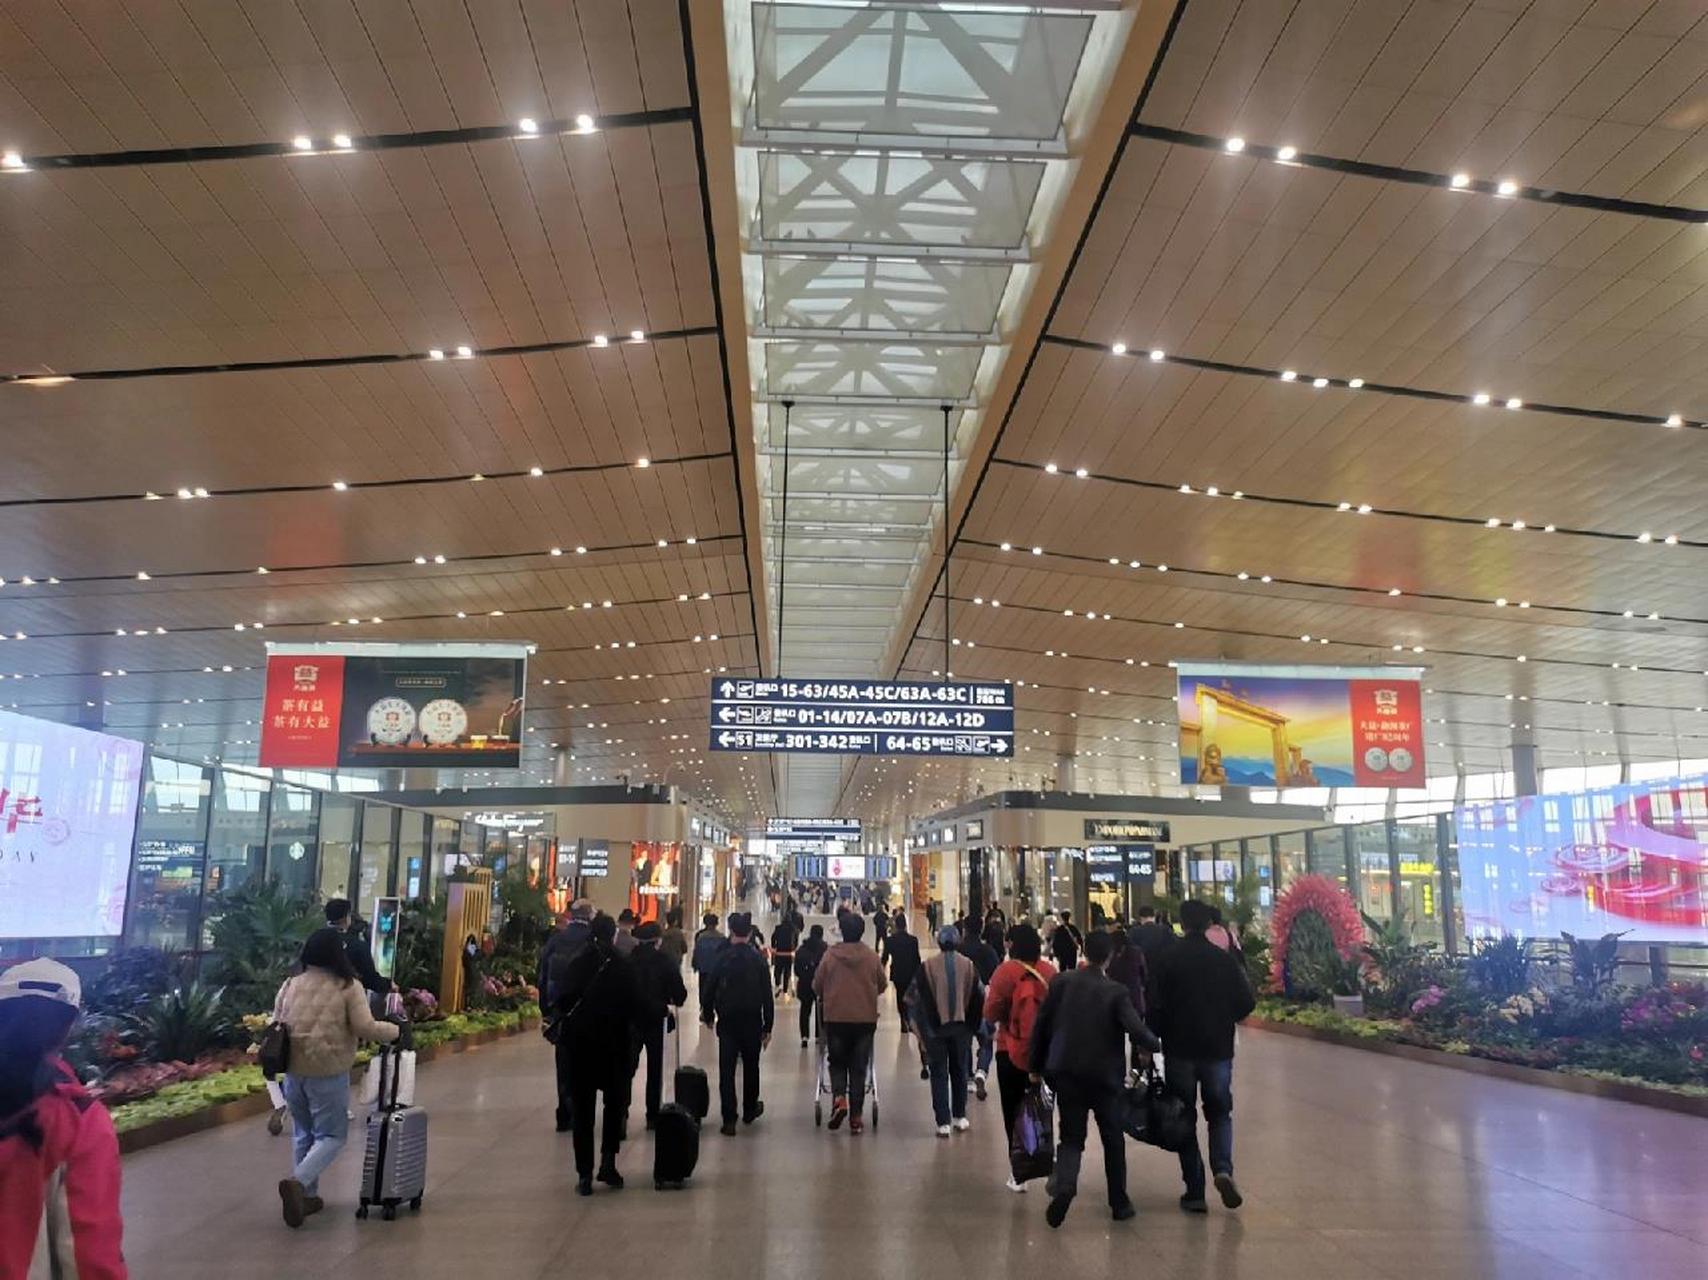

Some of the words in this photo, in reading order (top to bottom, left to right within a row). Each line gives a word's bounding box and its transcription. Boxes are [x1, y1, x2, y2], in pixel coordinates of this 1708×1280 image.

[781, 683, 967, 702] 15-63/45A-45C/63A-63C
[798, 709, 985, 727] 01-14/07A-07B/12A-12D
[736, 733, 752, 746] S1
[786, 734, 848, 749] 301-342
[886, 735, 931, 751] 64-65
